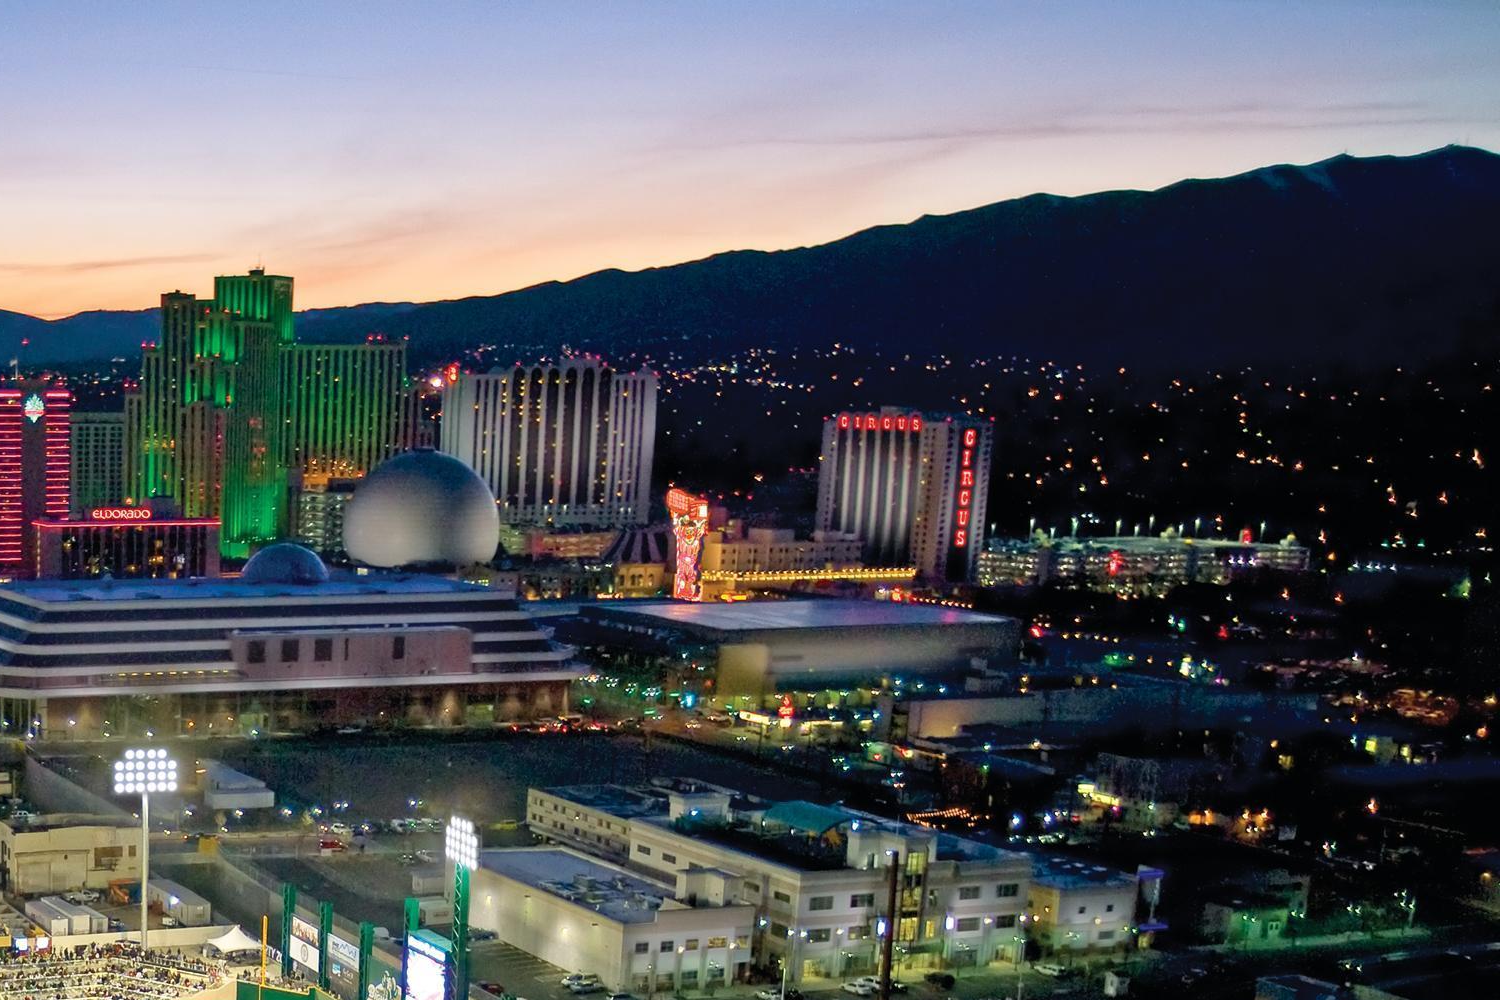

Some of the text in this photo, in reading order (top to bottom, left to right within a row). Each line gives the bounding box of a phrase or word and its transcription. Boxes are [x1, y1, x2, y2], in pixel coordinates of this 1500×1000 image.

[841, 416, 920, 430] CIRCUS
[956, 430, 975, 546] CIRCUS
[92, 509, 151, 520] ELDORADO
